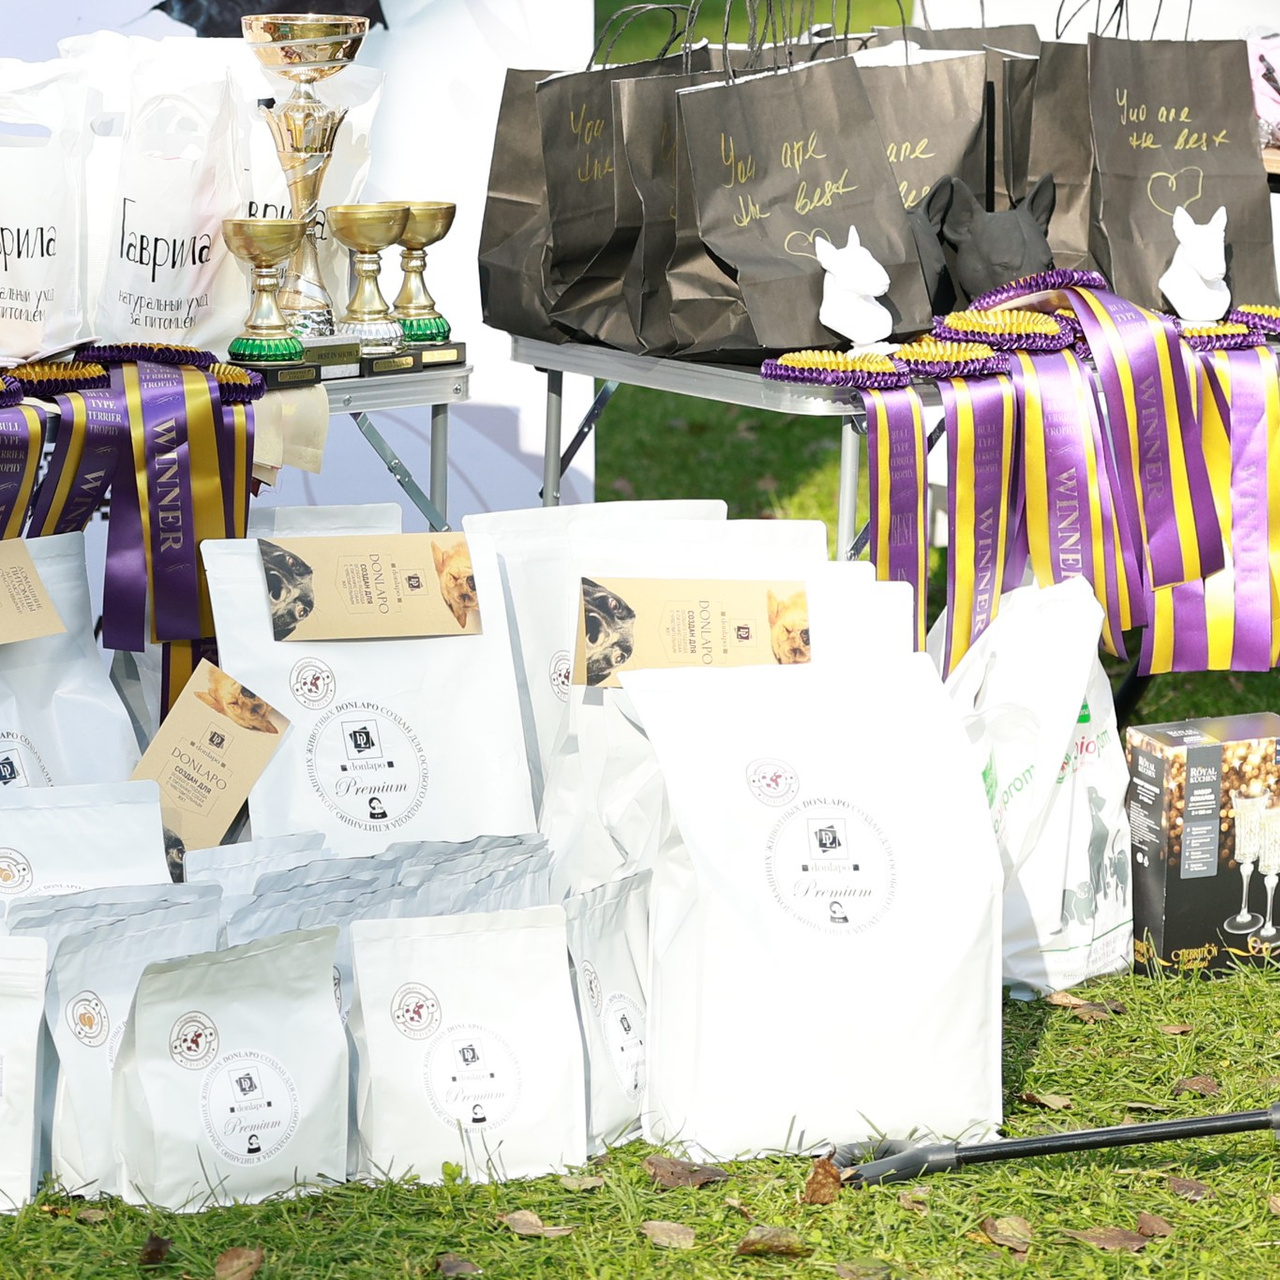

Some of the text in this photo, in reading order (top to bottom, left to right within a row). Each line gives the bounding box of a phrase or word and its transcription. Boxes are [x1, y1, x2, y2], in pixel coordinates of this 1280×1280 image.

[120, 197, 212, 282] Гаврила
[119, 290, 183, 313] натуральный
[130, 312, 141, 328] за
[142, 379, 178, 389] TROPHY
[88, 399, 117, 410] TYPE
[87, 411, 122, 423] TERRIER
[89, 424, 120, 436] TROPHY
[1138, 375, 1166, 500] WINNER
[153, 418, 183, 553] WINNER
[891, 514, 914, 547] BEST
[974, 506, 994, 636] WINNER
[360, 564, 373, 604] СОЗДАН ДЛЯ
[369, 554, 389, 614] DONLAPO
[687, 610, 697, 654] СОЗДАН ДЛЯ
[699, 600, 713, 665] DONLAPO
[335, 701, 379, 714] DONLAPO
[171, 747, 227, 790] DONLAPO
[349, 761, 386, 771] donlapo
[175, 766, 212, 795] СОЗДАН ДЛЯ
[335, 776, 408, 798] Premium
[802, 797, 850, 809] DONLAPO
[793, 877, 872, 898] Premium
[223, 1050, 260, 1064] DONLAPO
[445, 1086, 505, 1103] Premium
[223, 1116, 282, 1137] Premium
